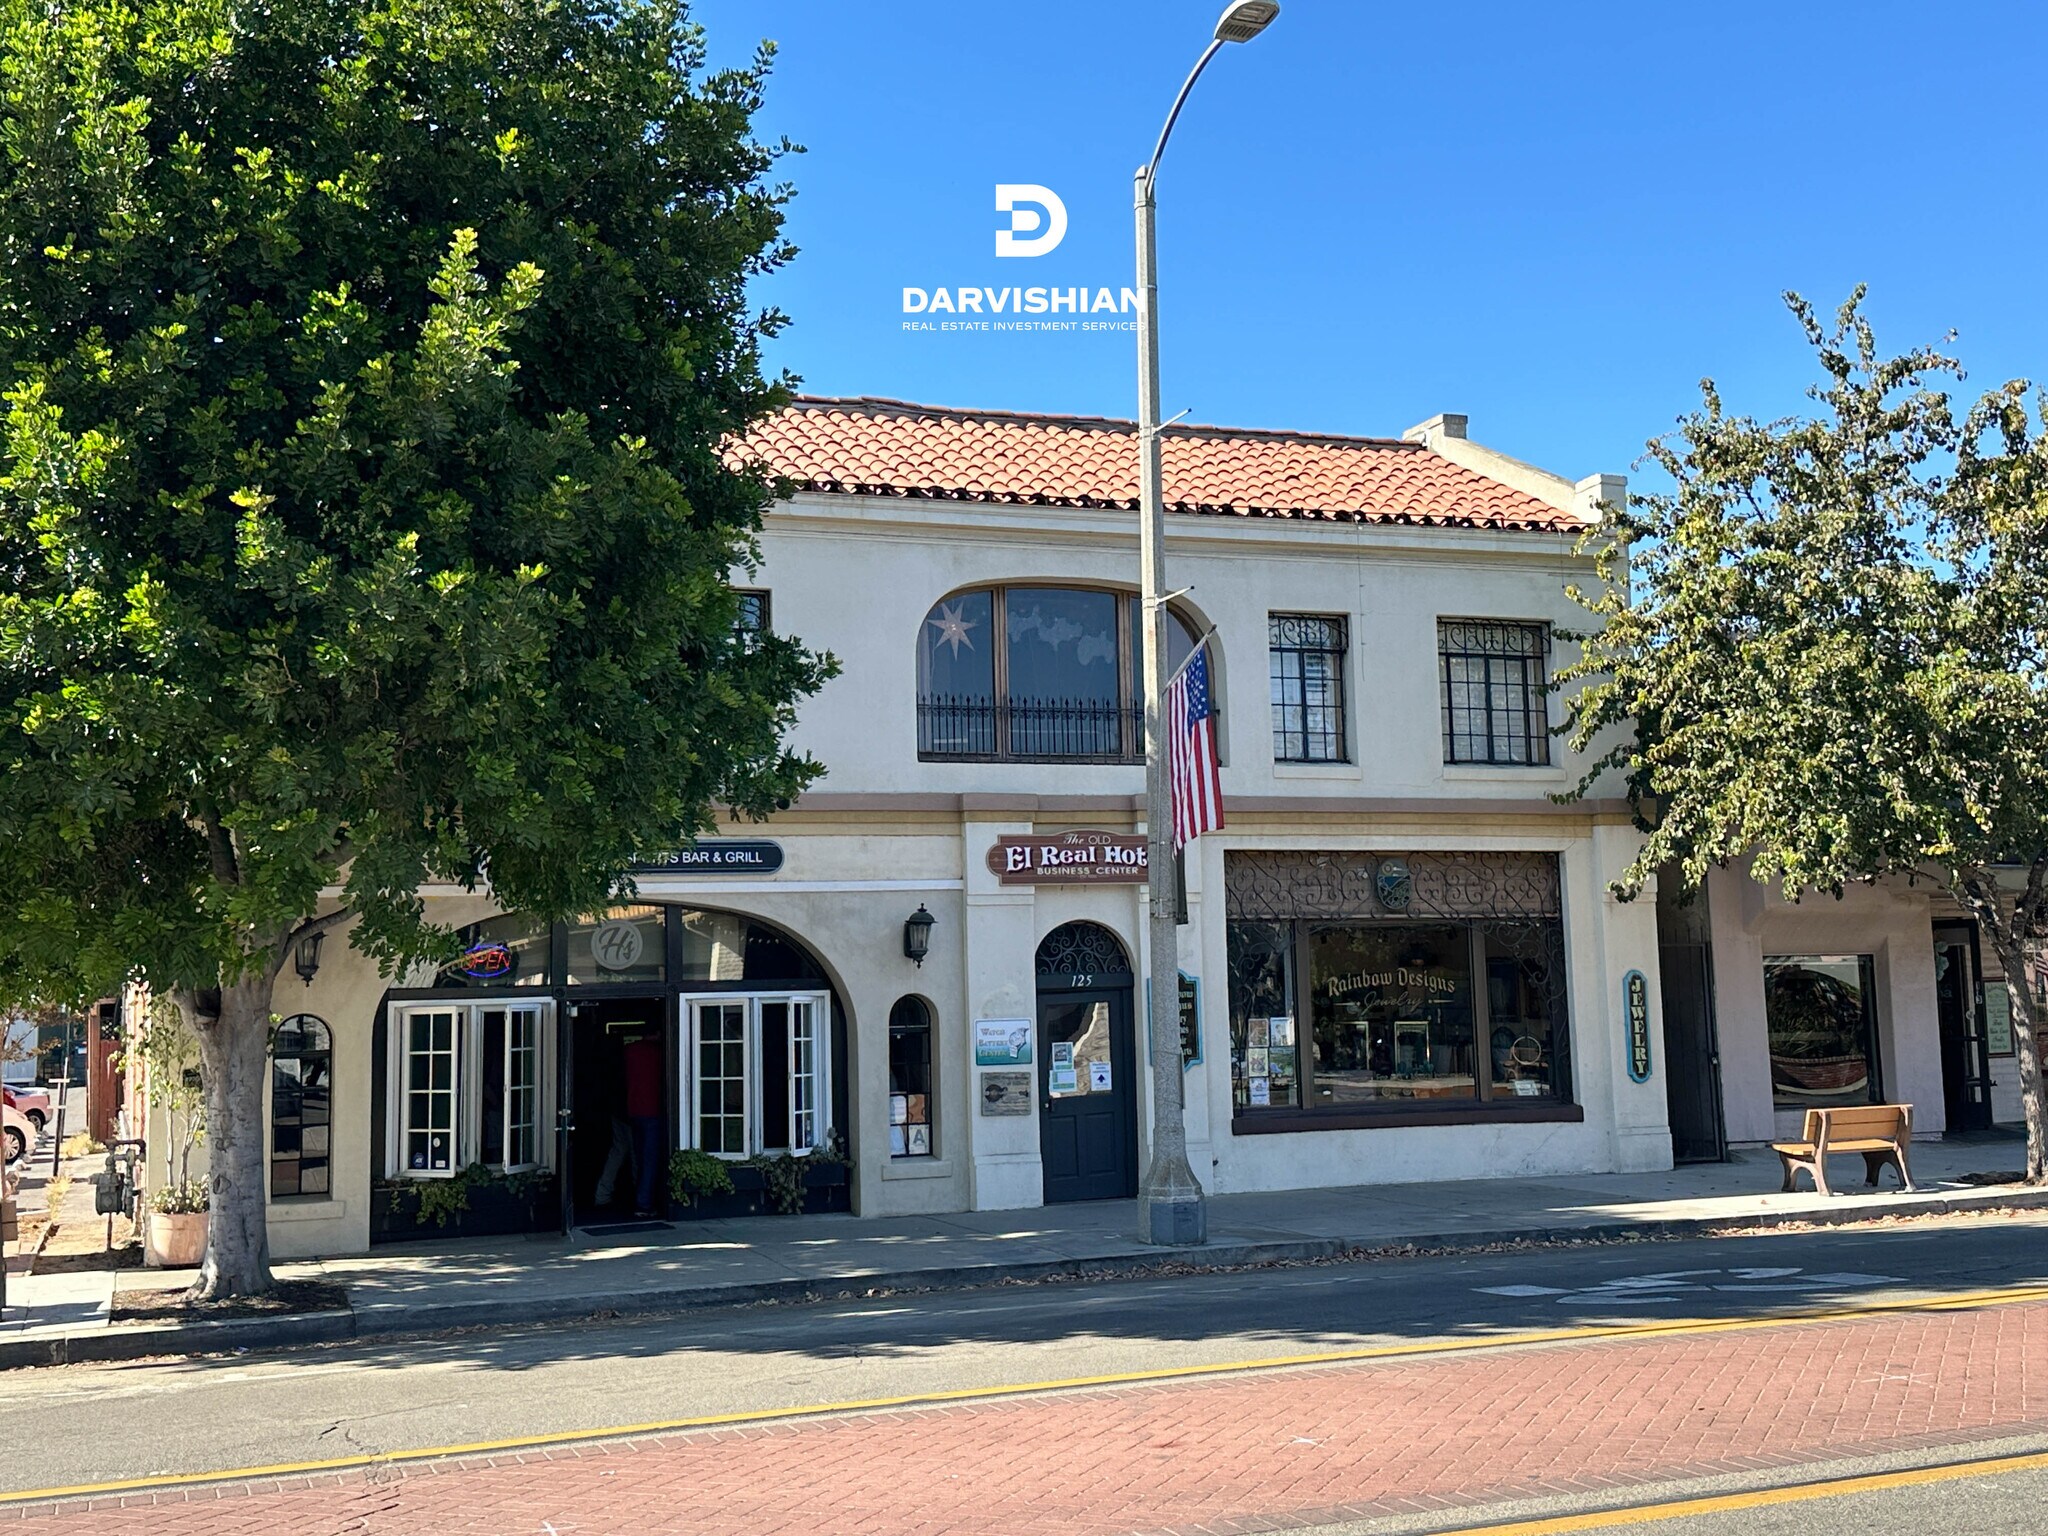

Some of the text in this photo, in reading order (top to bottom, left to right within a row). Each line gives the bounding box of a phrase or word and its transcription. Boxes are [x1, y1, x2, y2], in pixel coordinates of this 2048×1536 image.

[1063, 833, 1112, 845] The OLD
[682, 851, 710, 864] BAR
[713, 852, 722, 864] &
[725, 851, 763, 864] GRILL
[1005, 845, 1149, 872] El Real Hot
[1037, 866, 1139, 875] BUSINESS CENTER
[462, 951, 512, 972] OPEN
[1071, 974, 1093, 987] 125
[1327, 967, 1456, 997] Rainbow Designs
[1361, 991, 1421, 1016] Jewelry
[1630, 979, 1647, 1074] JEWELRY
[912, 1128, 926, 1145] A
